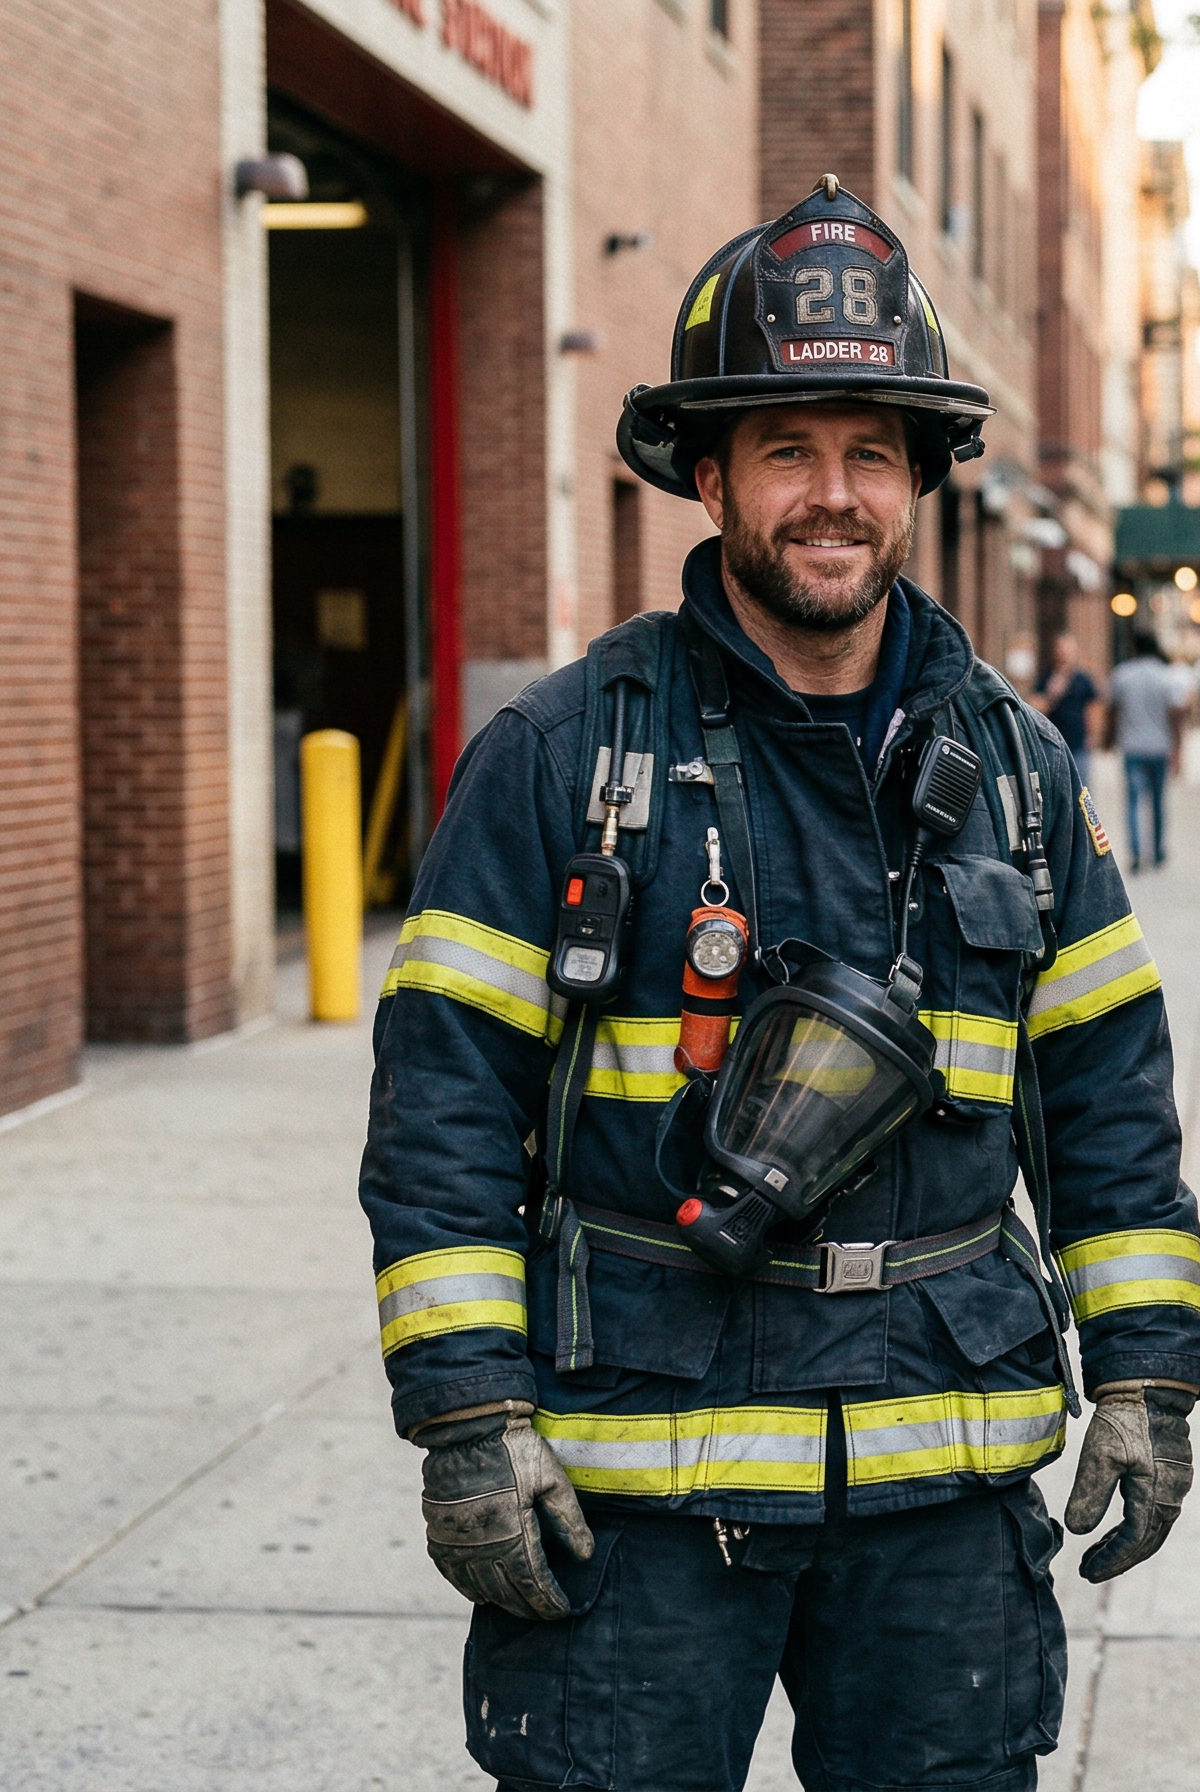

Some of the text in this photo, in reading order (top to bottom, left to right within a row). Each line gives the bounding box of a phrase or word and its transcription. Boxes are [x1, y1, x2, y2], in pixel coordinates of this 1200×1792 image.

[810, 223, 856, 243] FIRE
[794, 267, 878, 326] 28
[789, 341, 889, 363] LADDER 28
